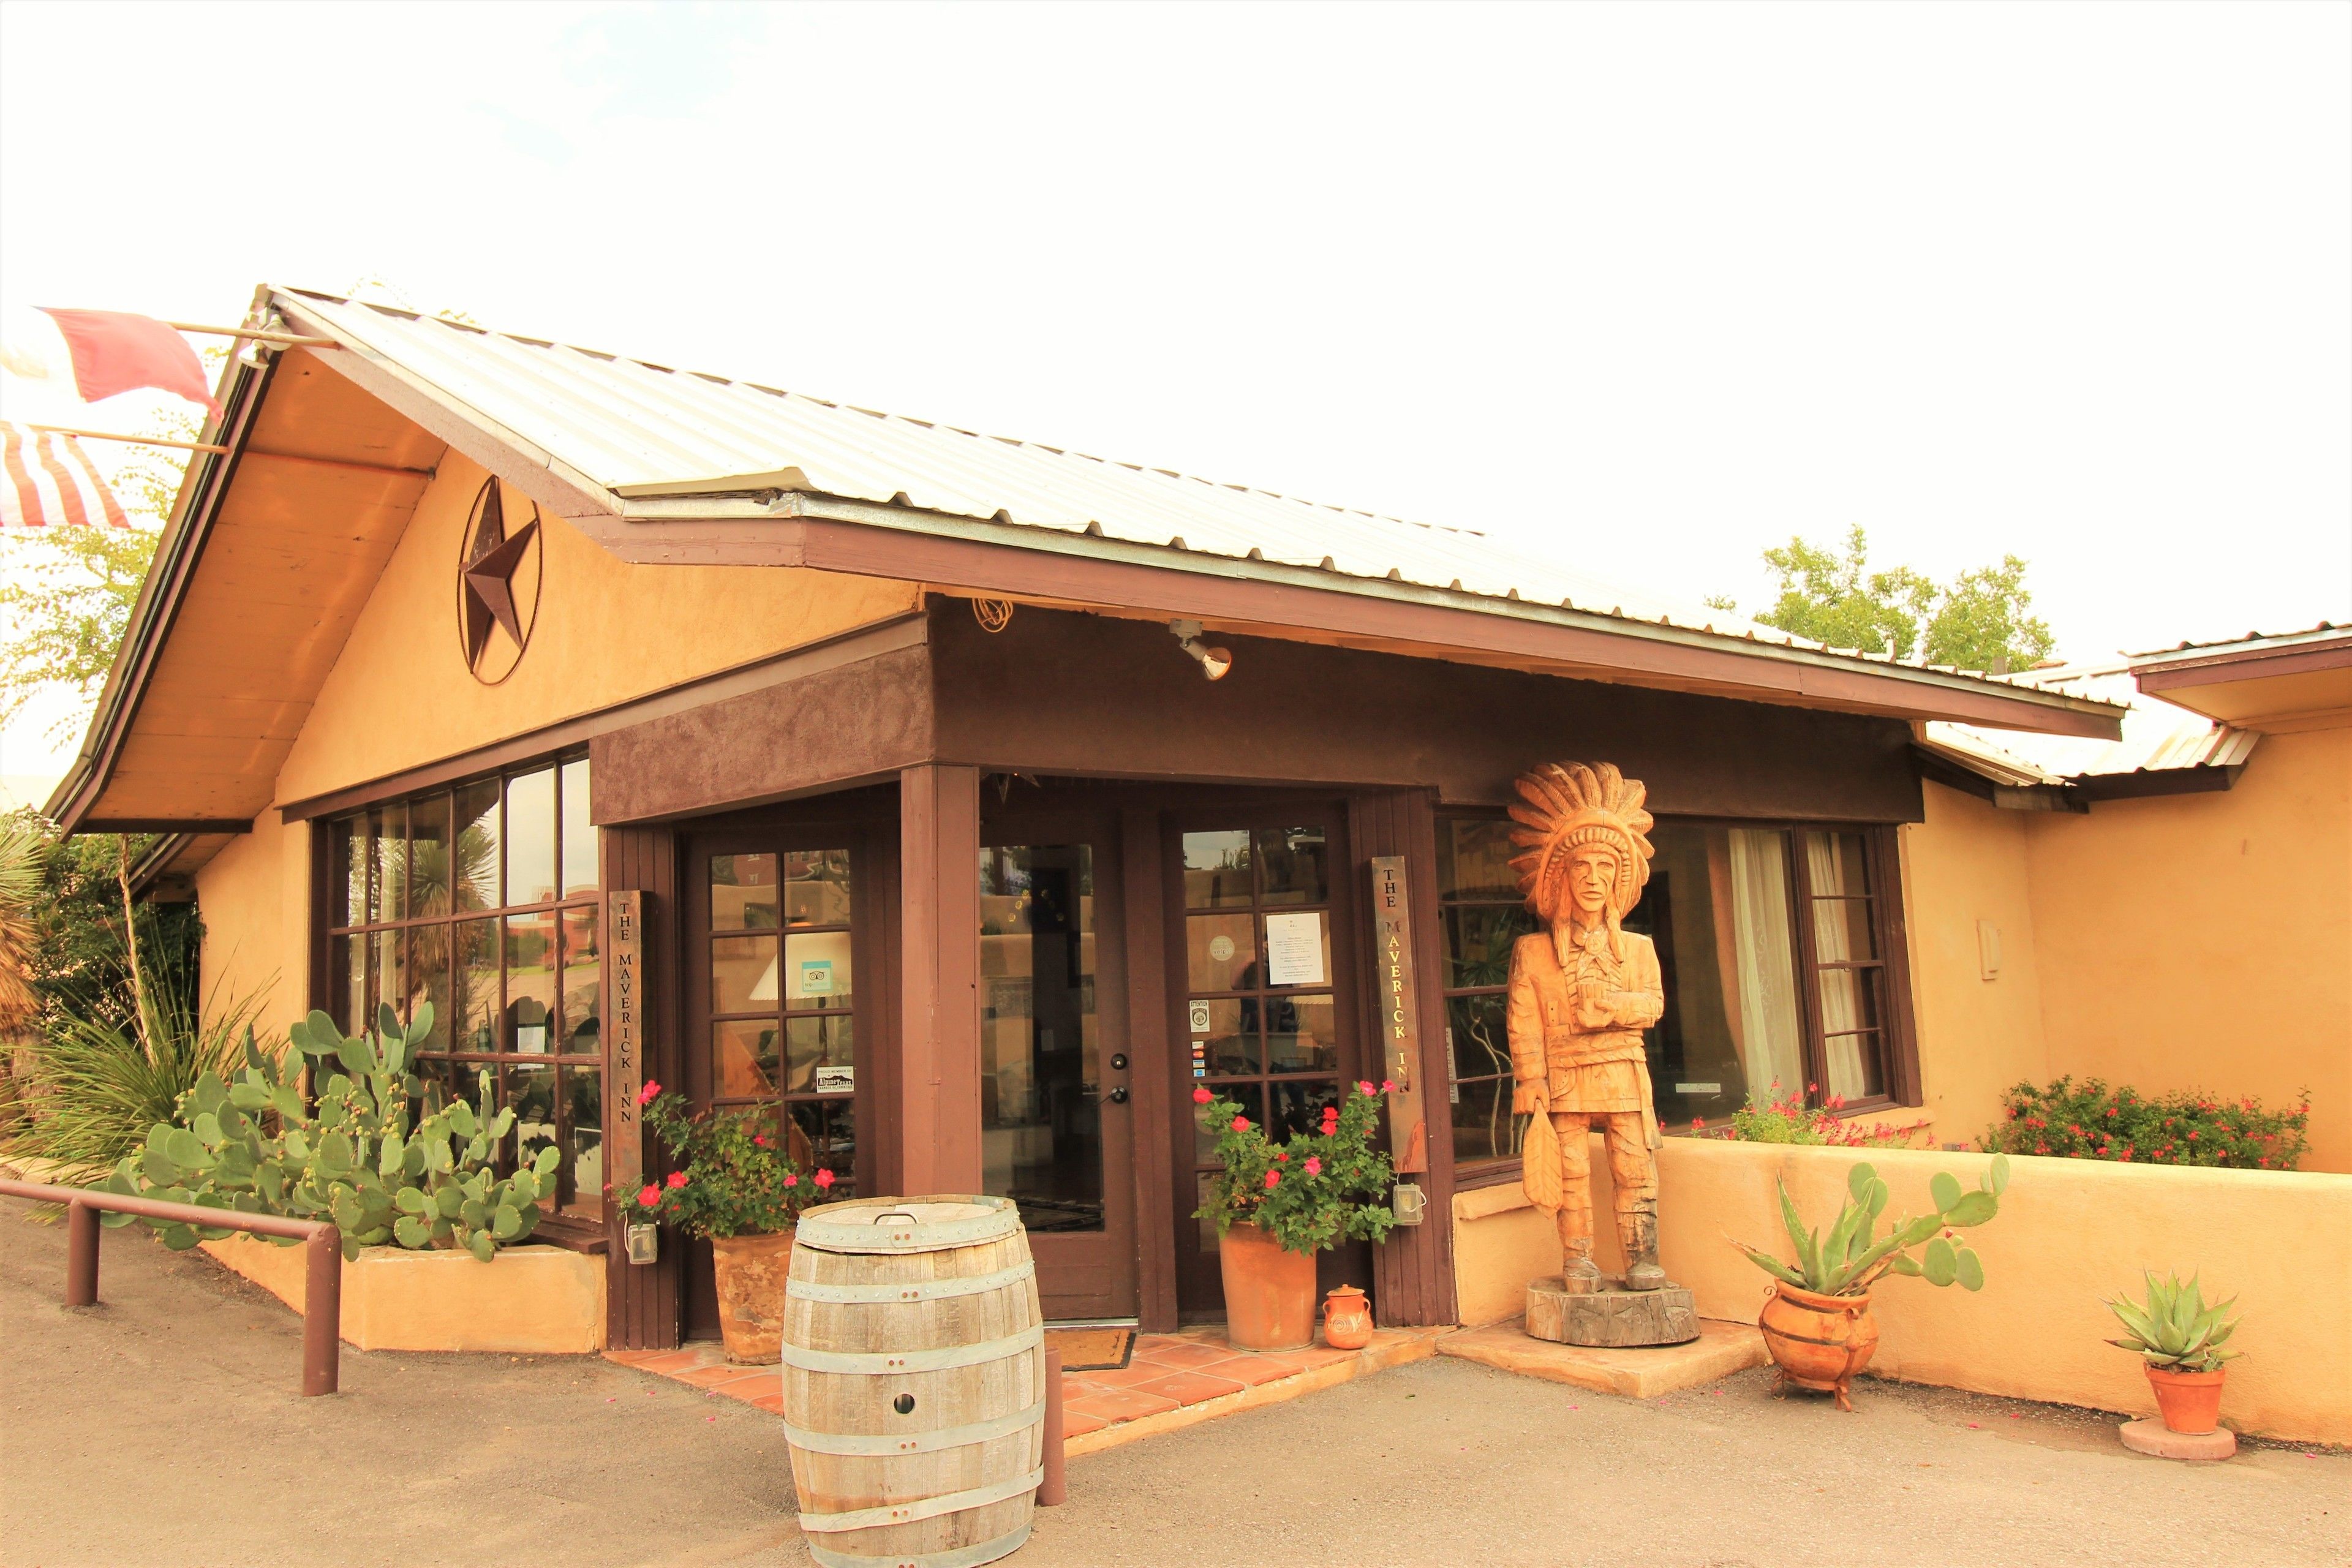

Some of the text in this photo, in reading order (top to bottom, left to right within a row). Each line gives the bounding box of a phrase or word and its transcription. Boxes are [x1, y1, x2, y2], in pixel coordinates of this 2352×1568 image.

[1383, 869, 1396, 908] THE
[619, 903, 632, 1122] THE MAVERICK INN
[1385, 921, 1406, 1039] MAVERICK
